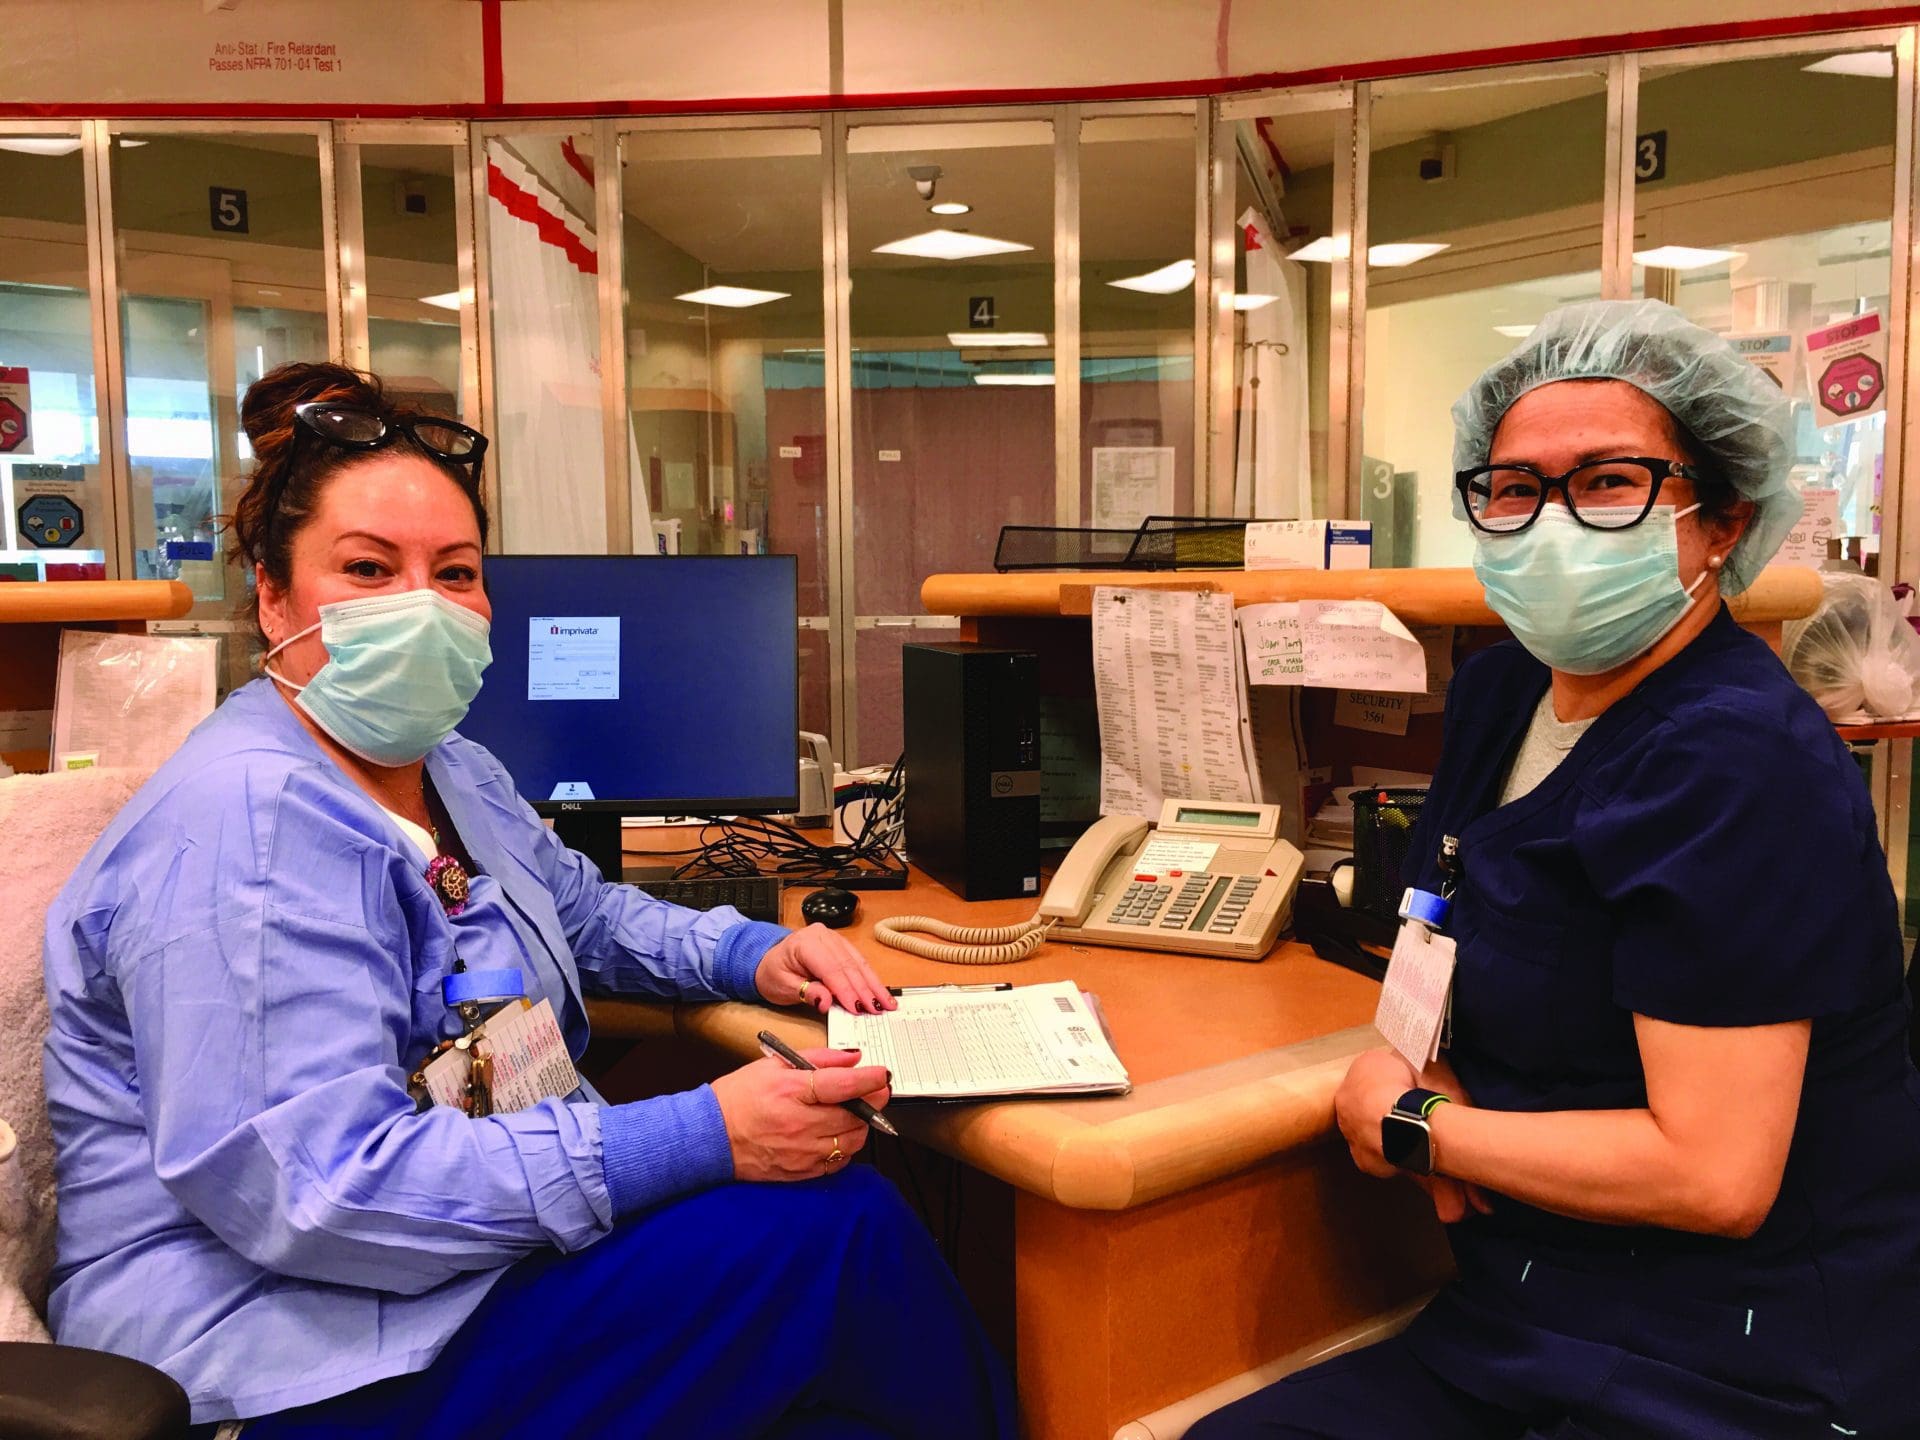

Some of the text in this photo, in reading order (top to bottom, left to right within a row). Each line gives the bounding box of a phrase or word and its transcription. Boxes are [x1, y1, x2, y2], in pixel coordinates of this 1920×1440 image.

[267, 41, 285, 55] Fire
[288, 42, 336, 56] Retardant
[209, 57, 342, 72] Passes NFPA 701-04 Test 1
[1636, 139, 1658, 178] 3
[218, 194, 240, 225] 5
[973, 299, 990, 325] 4
[1825, 324, 1858, 344] STOP
[1739, 339, 1770, 351] STOP
[30, 466, 63, 478] STOP
[1373, 464, 1391, 499] 3
[560, 626, 598, 636] imprivata
[1350, 692, 1404, 711] SECURITY
[1363, 711, 1385, 724] 3561
